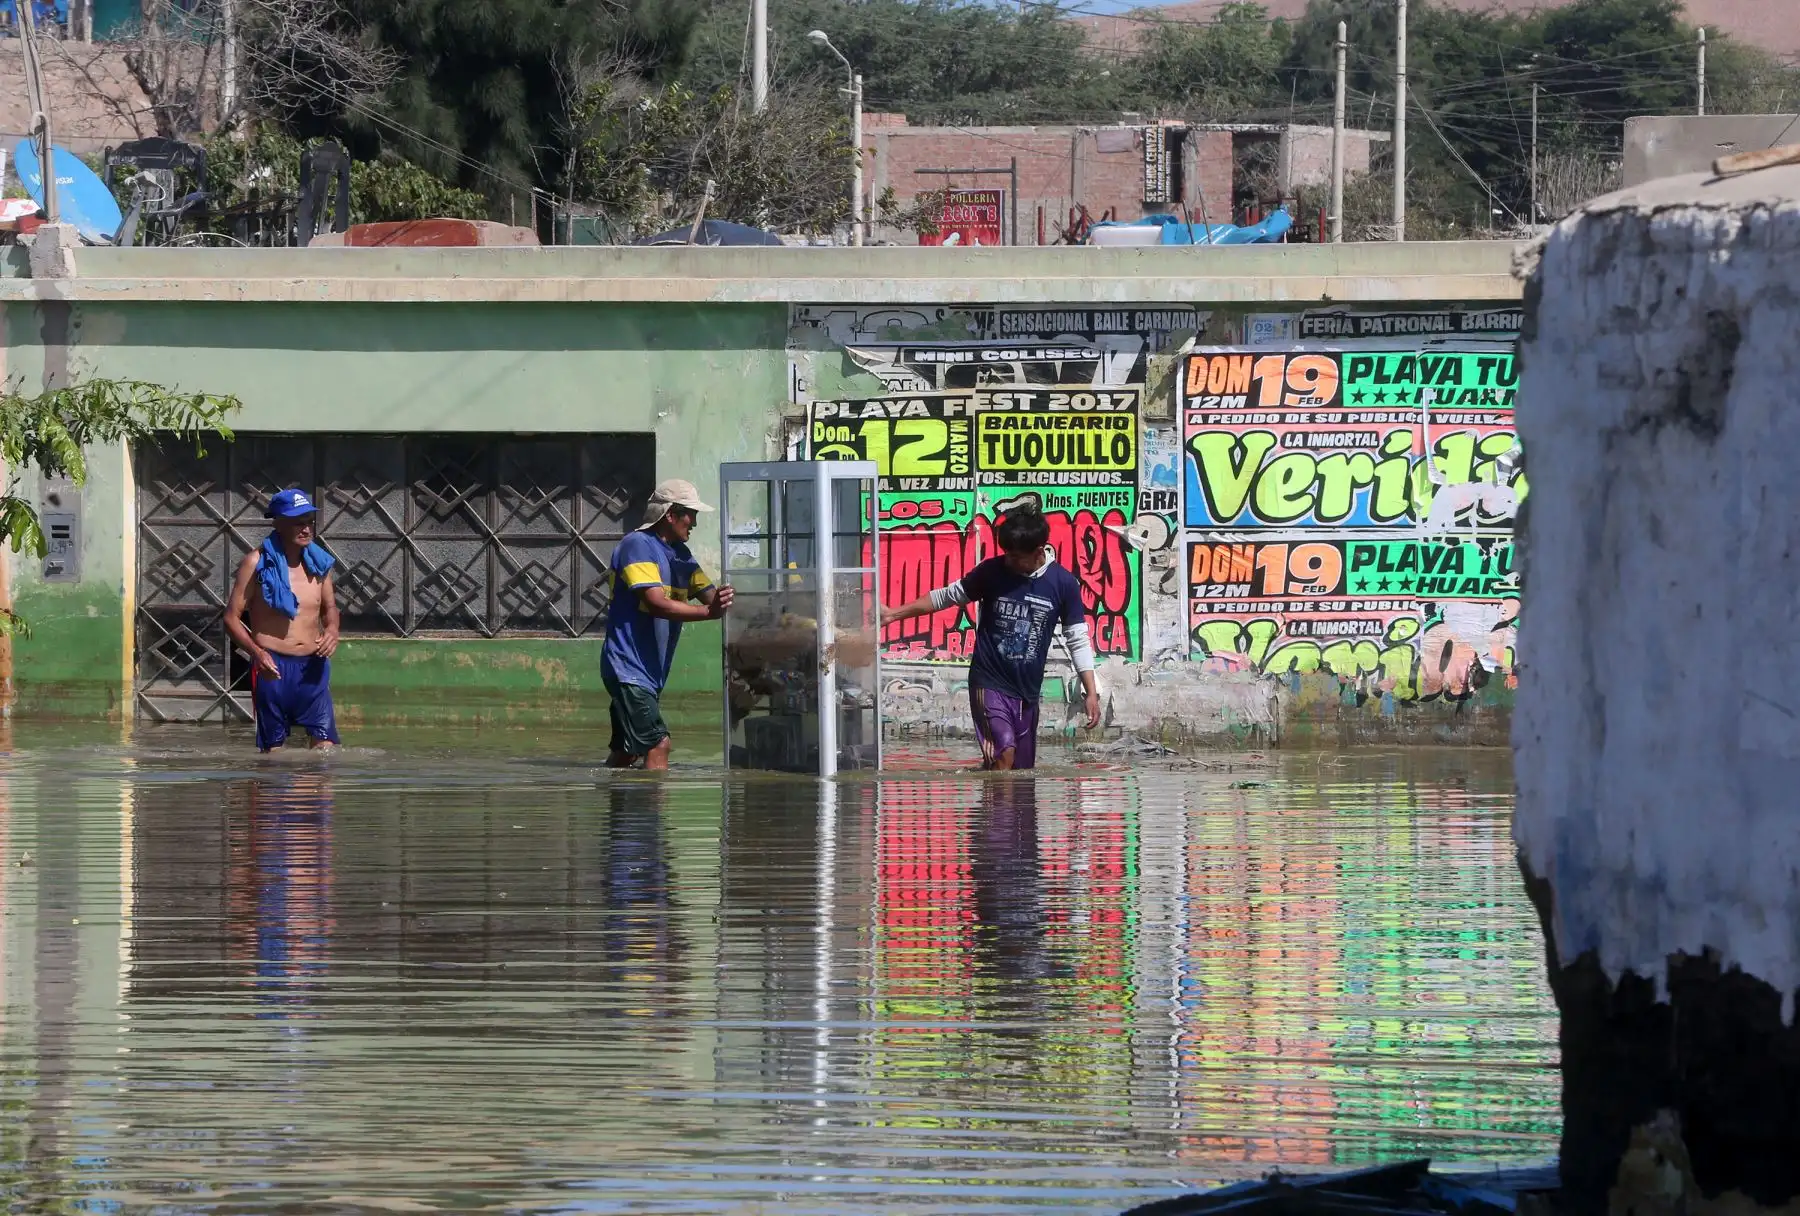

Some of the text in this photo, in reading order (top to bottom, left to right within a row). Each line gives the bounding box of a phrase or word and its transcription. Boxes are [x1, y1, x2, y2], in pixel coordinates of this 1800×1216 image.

[951, 193, 996, 203] POLLERIA
[1002, 312, 1090, 333] SENSACIONAL
[1094, 311, 1130, 332] BAILE
[1303, 314, 1354, 334] FERIA
[1359, 312, 1455, 334] PATRONAL
[914, 348, 1102, 362] MINI COLISEO
[1186, 355, 1253, 396] DOM
[1253, 354, 1340, 407] 19
[1347, 355, 1463, 386] PLAYA
[814, 400, 932, 420] PLAYA
[1048, 393, 1137, 412] 2017
[1187, 395, 1247, 409] 12M
[1298, 396, 1324, 406] FEB
[984, 416, 1130, 431] BALNEARIO
[1189, 414, 1205, 424] A
[1208, 413, 1280, 424] PEDIDO
[1286, 413, 1312, 424] DE
[1315, 412, 1346, 424] SU
[859, 418, 950, 477] 12
[950, 419, 969, 475] MARZO
[1283, 433, 1379, 448] LA INMORTAL
[982, 433, 1132, 468] TUQUILLO
[1076, 491, 1130, 508] FUENTES
[1190, 544, 1255, 584] DOM
[1255, 543, 1343, 596] 19
[1350, 543, 1465, 575] PLAYA
[1191, 584, 1251, 598] 12M
[1302, 585, 1327, 593] FEB
[1195, 601, 1210, 613] A
[1213, 601, 1285, 613] PEDIDO
[1289, 601, 1314, 612] DE
[1318, 600, 1348, 612] SU
[1289, 620, 1383, 636] LA INMORTAL
